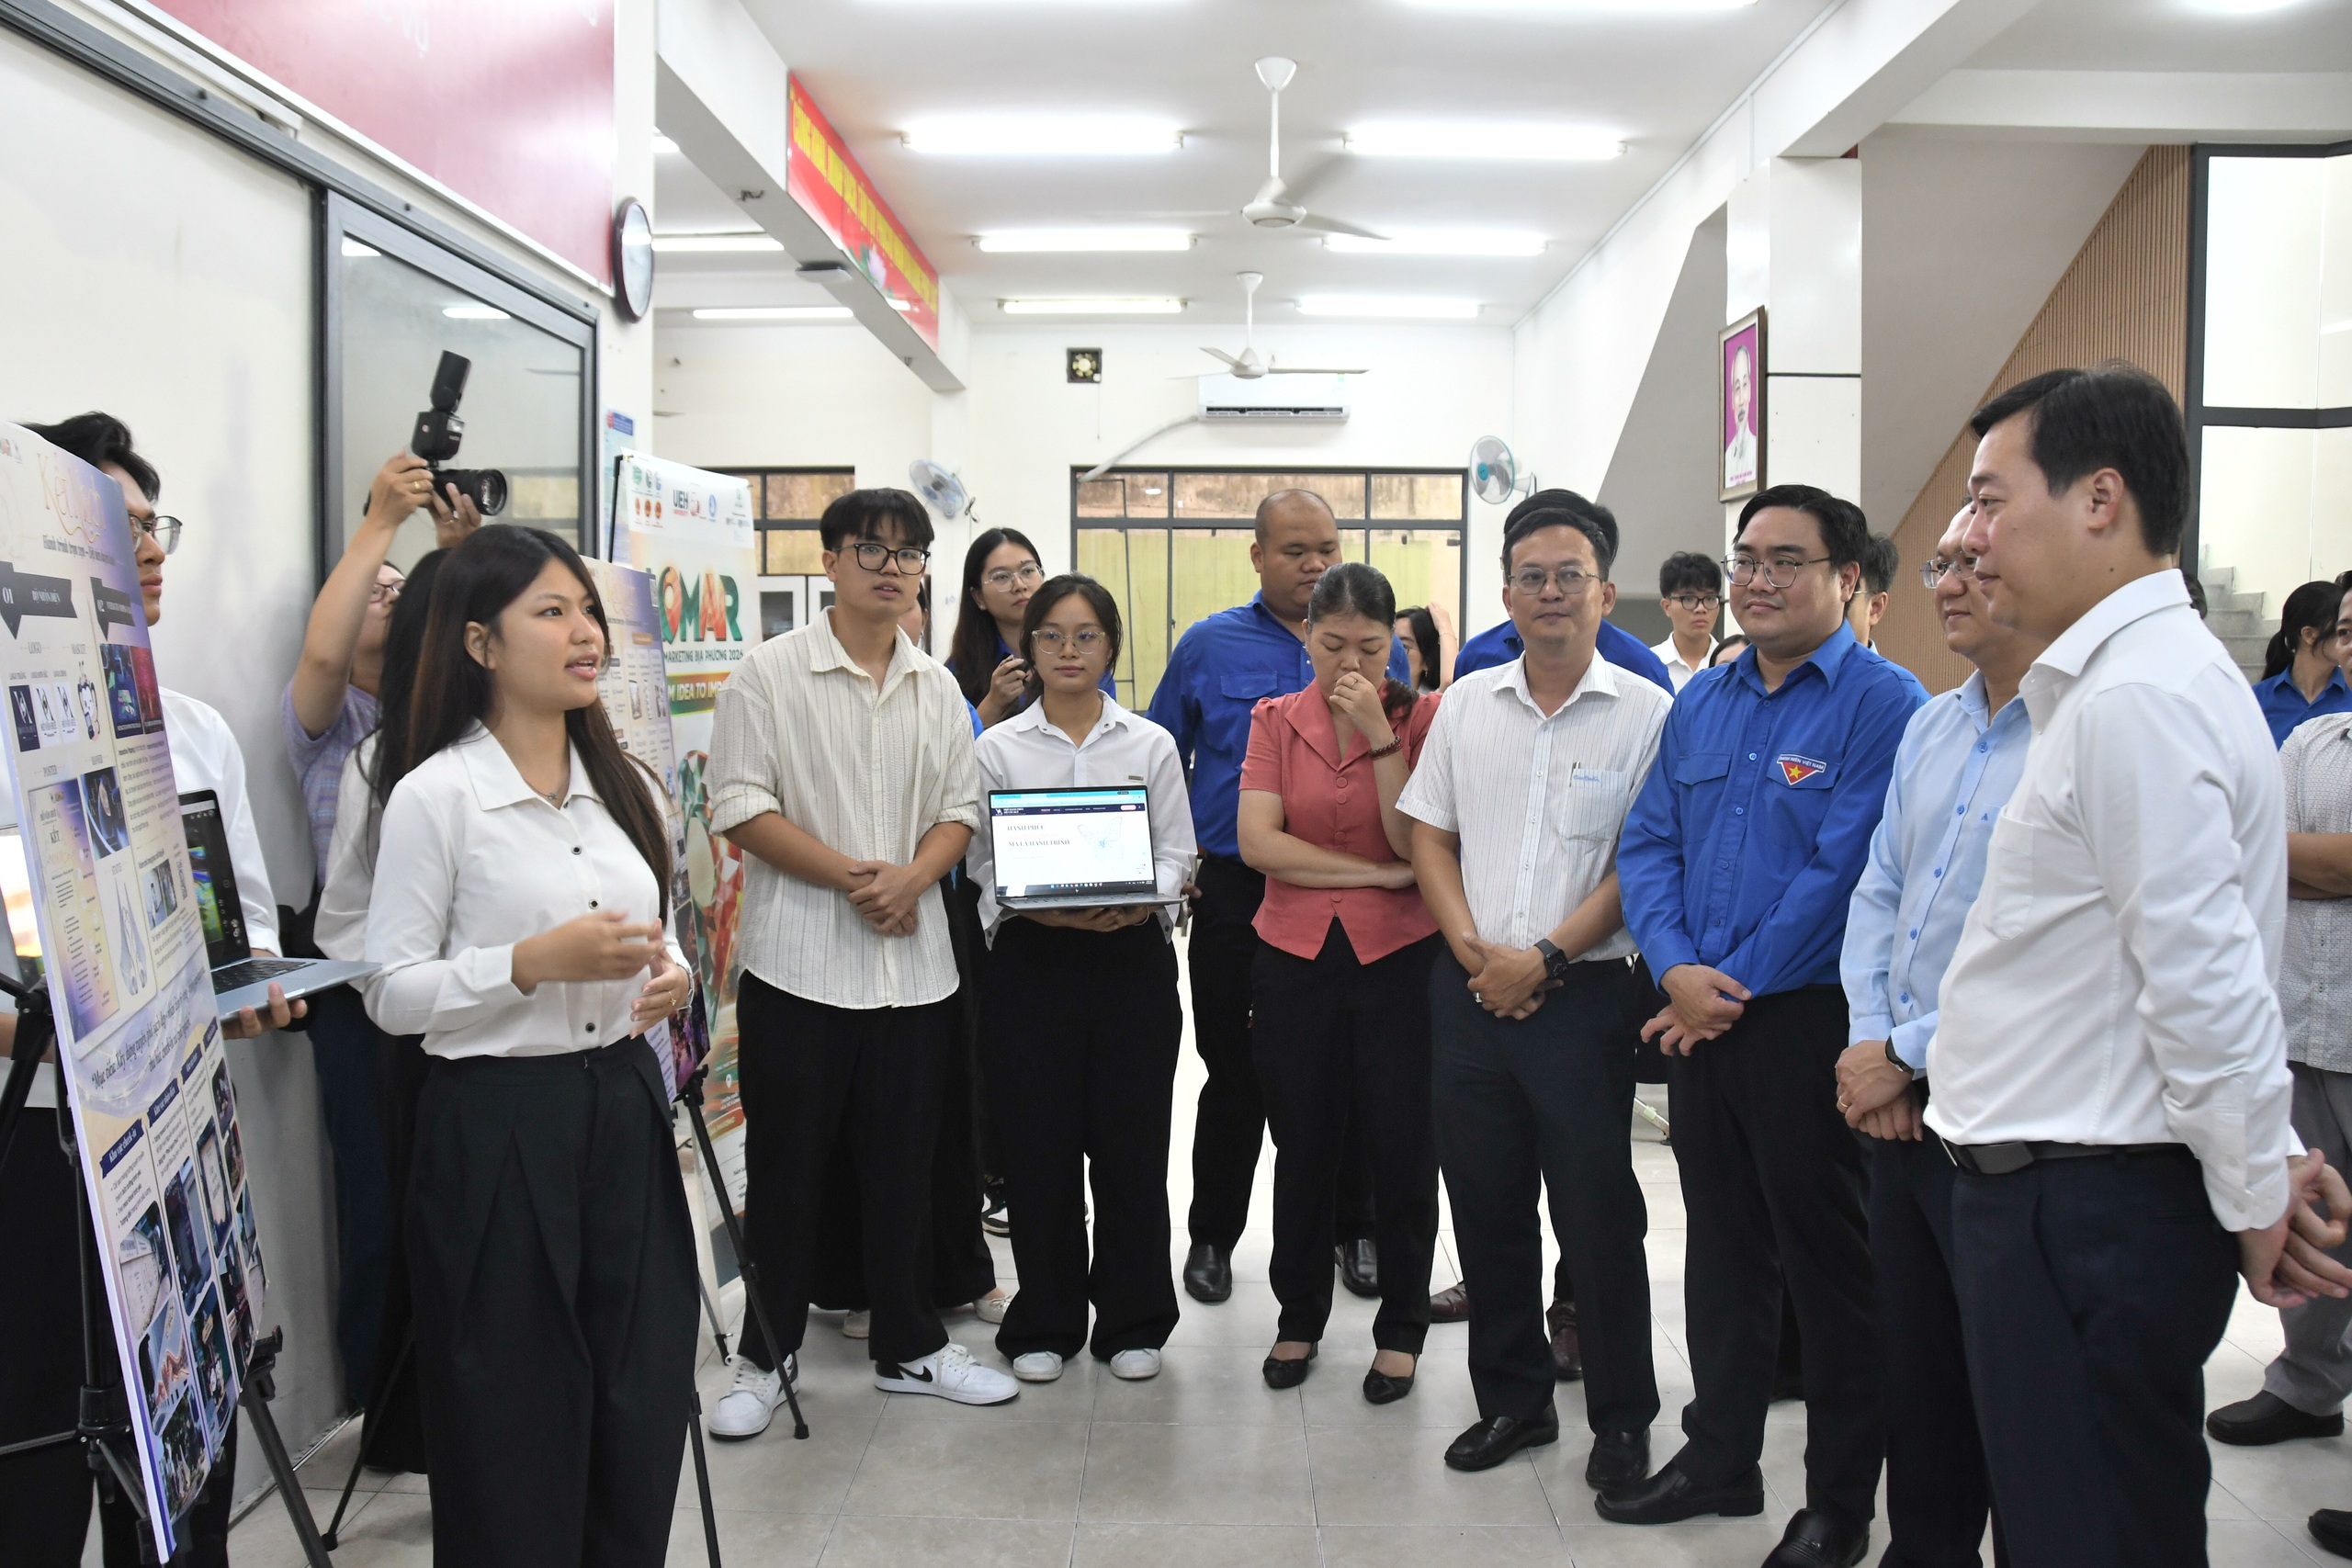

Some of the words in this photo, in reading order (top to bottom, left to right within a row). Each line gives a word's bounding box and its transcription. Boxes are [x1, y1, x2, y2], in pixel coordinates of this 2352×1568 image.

[673, 489, 688, 509] UEH
[3, 587, 14, 604] 01
[646, 567, 742, 644] OMAR
[677, 682, 694, 700] IDEA
[695, 682, 706, 698] TO
[707, 681, 723, 696] IMP
